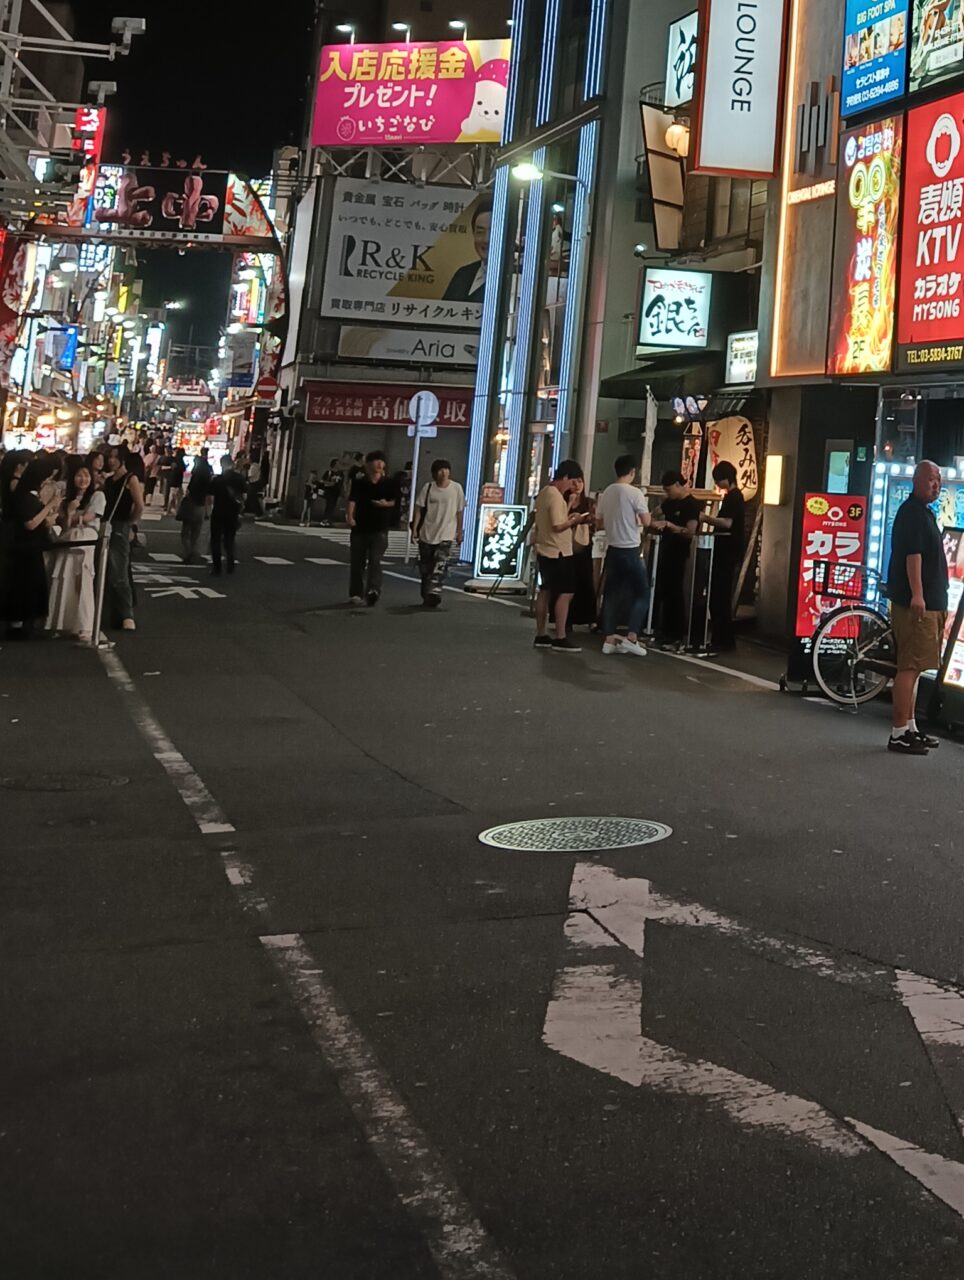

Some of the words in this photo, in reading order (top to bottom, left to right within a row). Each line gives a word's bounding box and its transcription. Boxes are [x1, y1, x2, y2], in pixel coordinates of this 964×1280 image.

[867, 2, 884, 21] FOOT
[319, 46, 468, 82] 入店応援金
[731, 2, 757, 112] LOUNGE
[343, 82, 438, 108] プレゼント!
[358, 115, 436, 133] いちごなび
[342, 191, 376, 206] 貴金属
[382, 195, 405, 208] 宝石
[442, 201, 466, 213] 時計
[358, 239, 436, 272] R&K
[916, 223, 963, 267] KTV
[356, 269, 405, 282] RECYCLE
[407, 272, 435, 284] KING
[914, 272, 962, 300] カラオケ
[913, 298, 961, 322] MYSONG
[411, 338, 456, 359] Aria
[313, 396, 364, 407] ブランド品
[367, 396, 467, 423] 高価取
[849, 507, 862, 518] 3F
[805, 530, 861, 557] カラ
